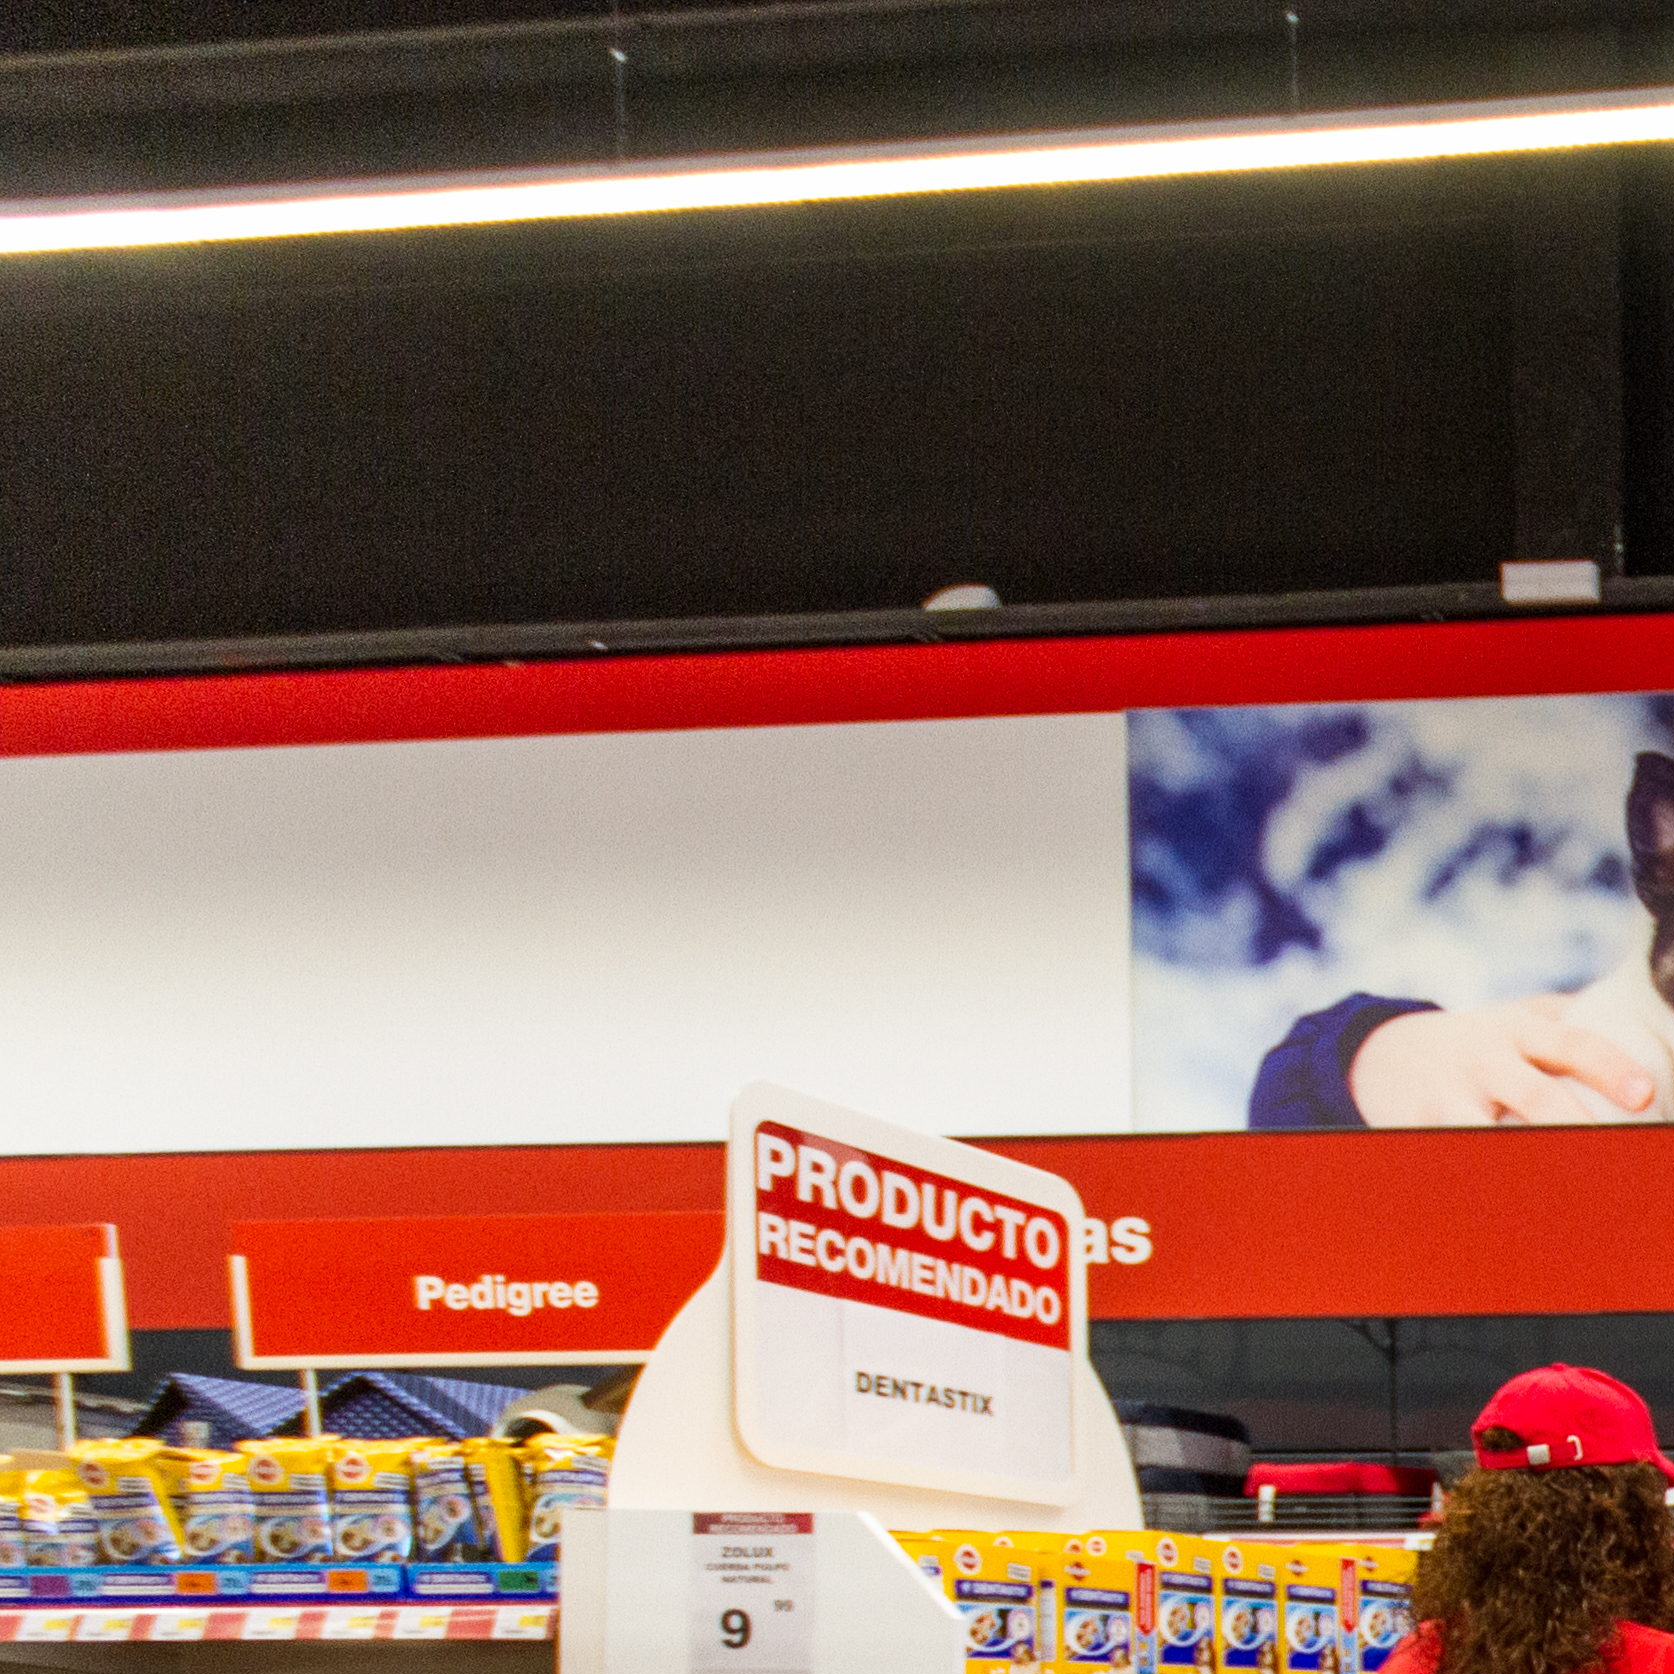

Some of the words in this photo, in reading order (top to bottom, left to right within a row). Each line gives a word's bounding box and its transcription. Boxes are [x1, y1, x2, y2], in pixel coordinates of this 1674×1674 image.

[757, 1132, 1060, 1269] PRODUCTO
[758, 1211, 1061, 1325] RECOMENDADO
[416, 1275, 599, 1317] Pedigree
[855, 1370, 994, 1417] DENTASTIX
[721, 1547, 774, 1558] ZOLUX
[720, 1608, 752, 1649] 9
